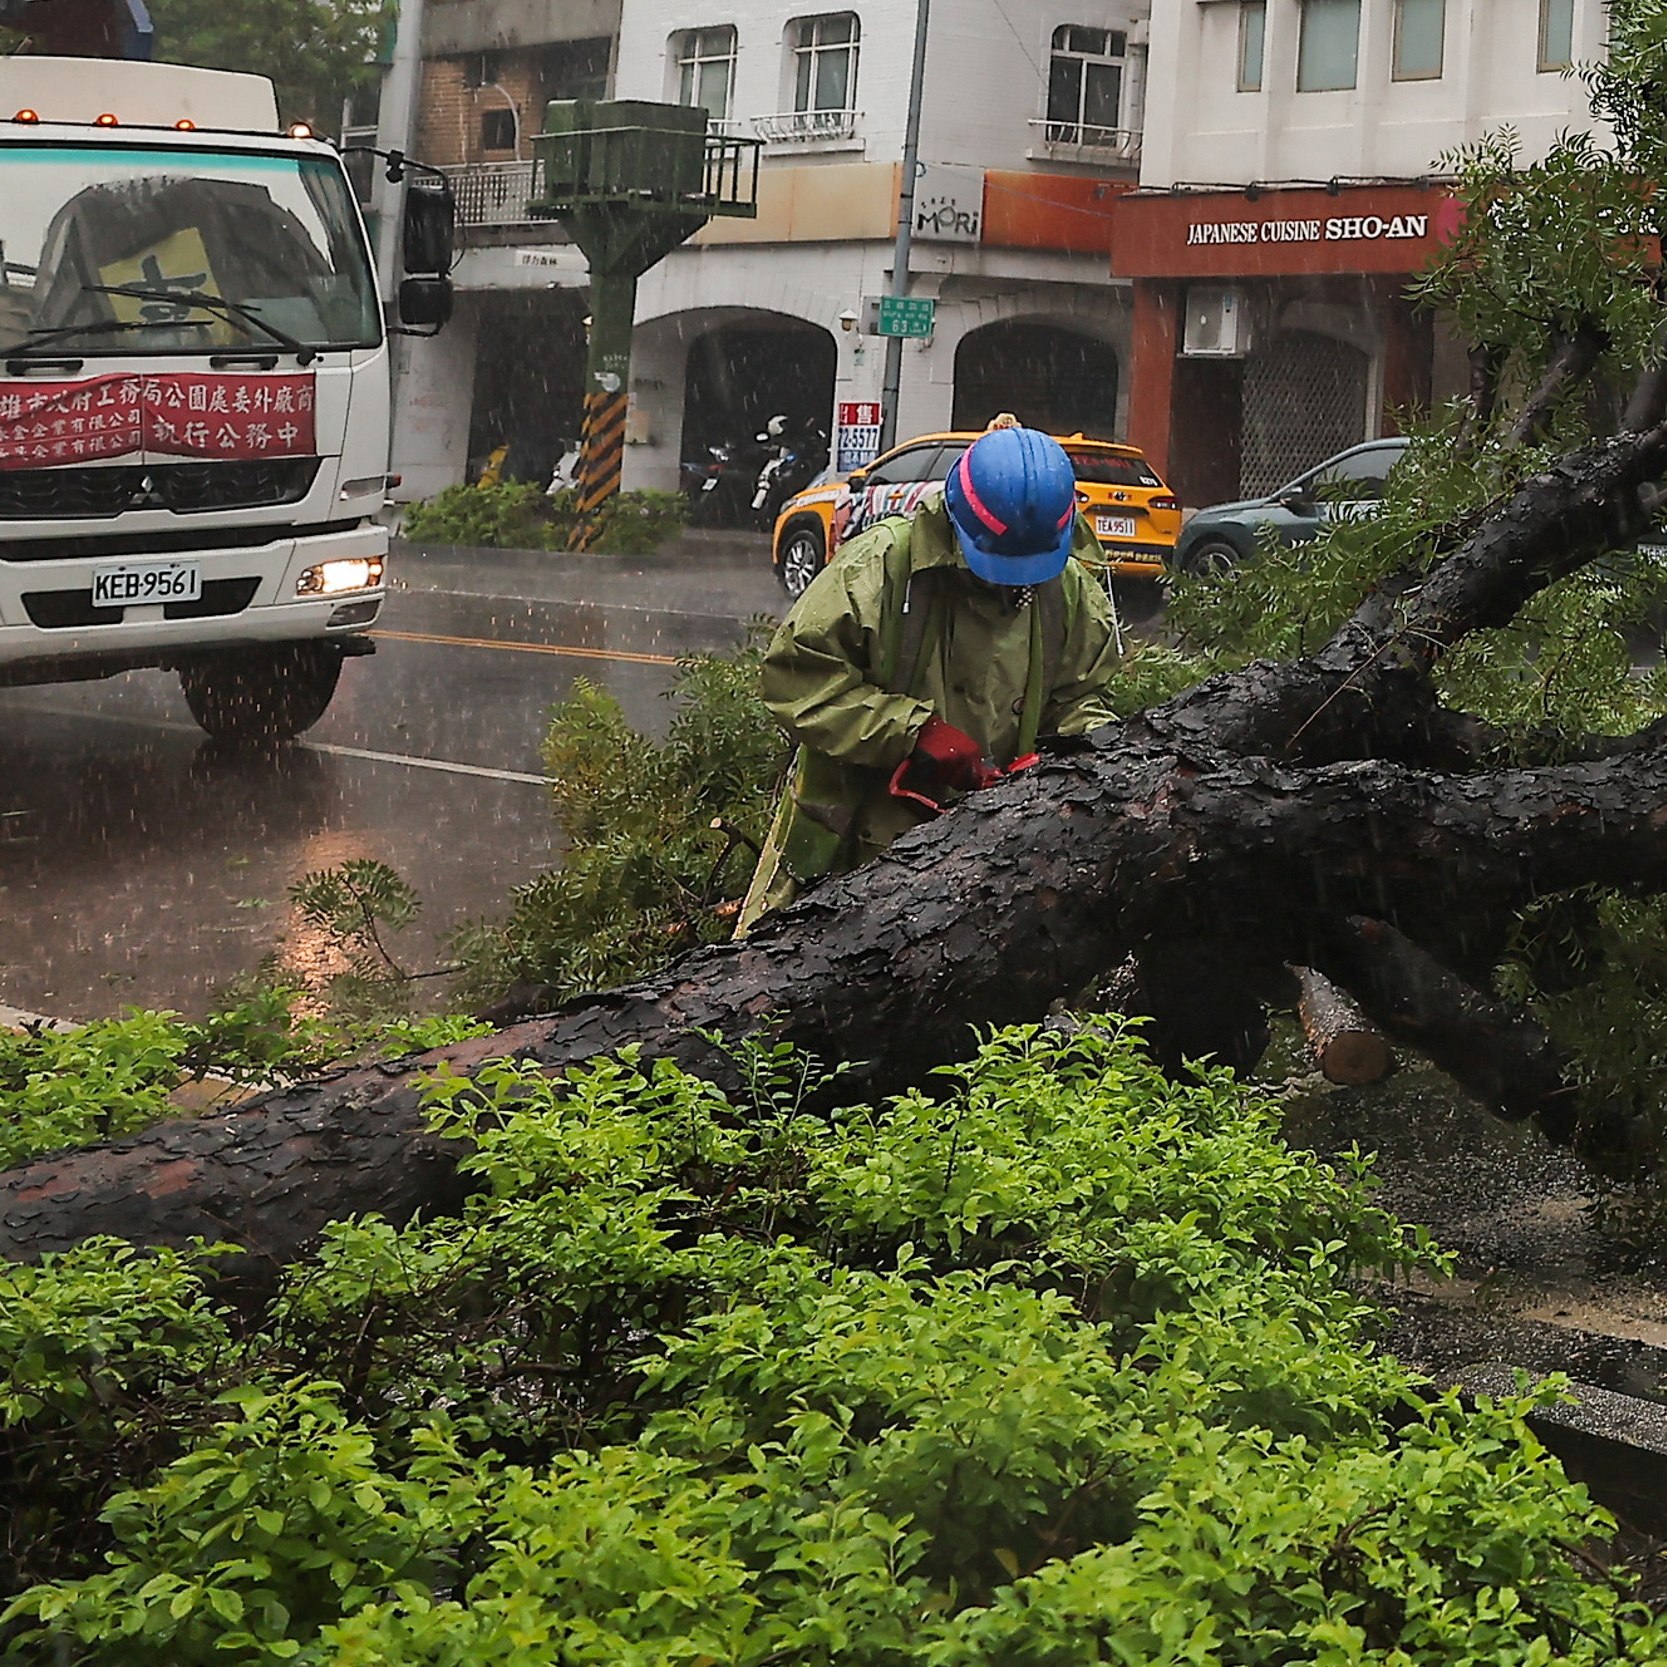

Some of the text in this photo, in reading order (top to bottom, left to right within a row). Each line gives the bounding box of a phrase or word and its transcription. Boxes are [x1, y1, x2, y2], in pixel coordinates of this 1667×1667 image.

[1186, 215, 1429, 246] JAPANESE CUISINE SHO-AN
[152, 414, 299, 449] 執行公務中
[95, 569, 198, 601] KEB-9561
